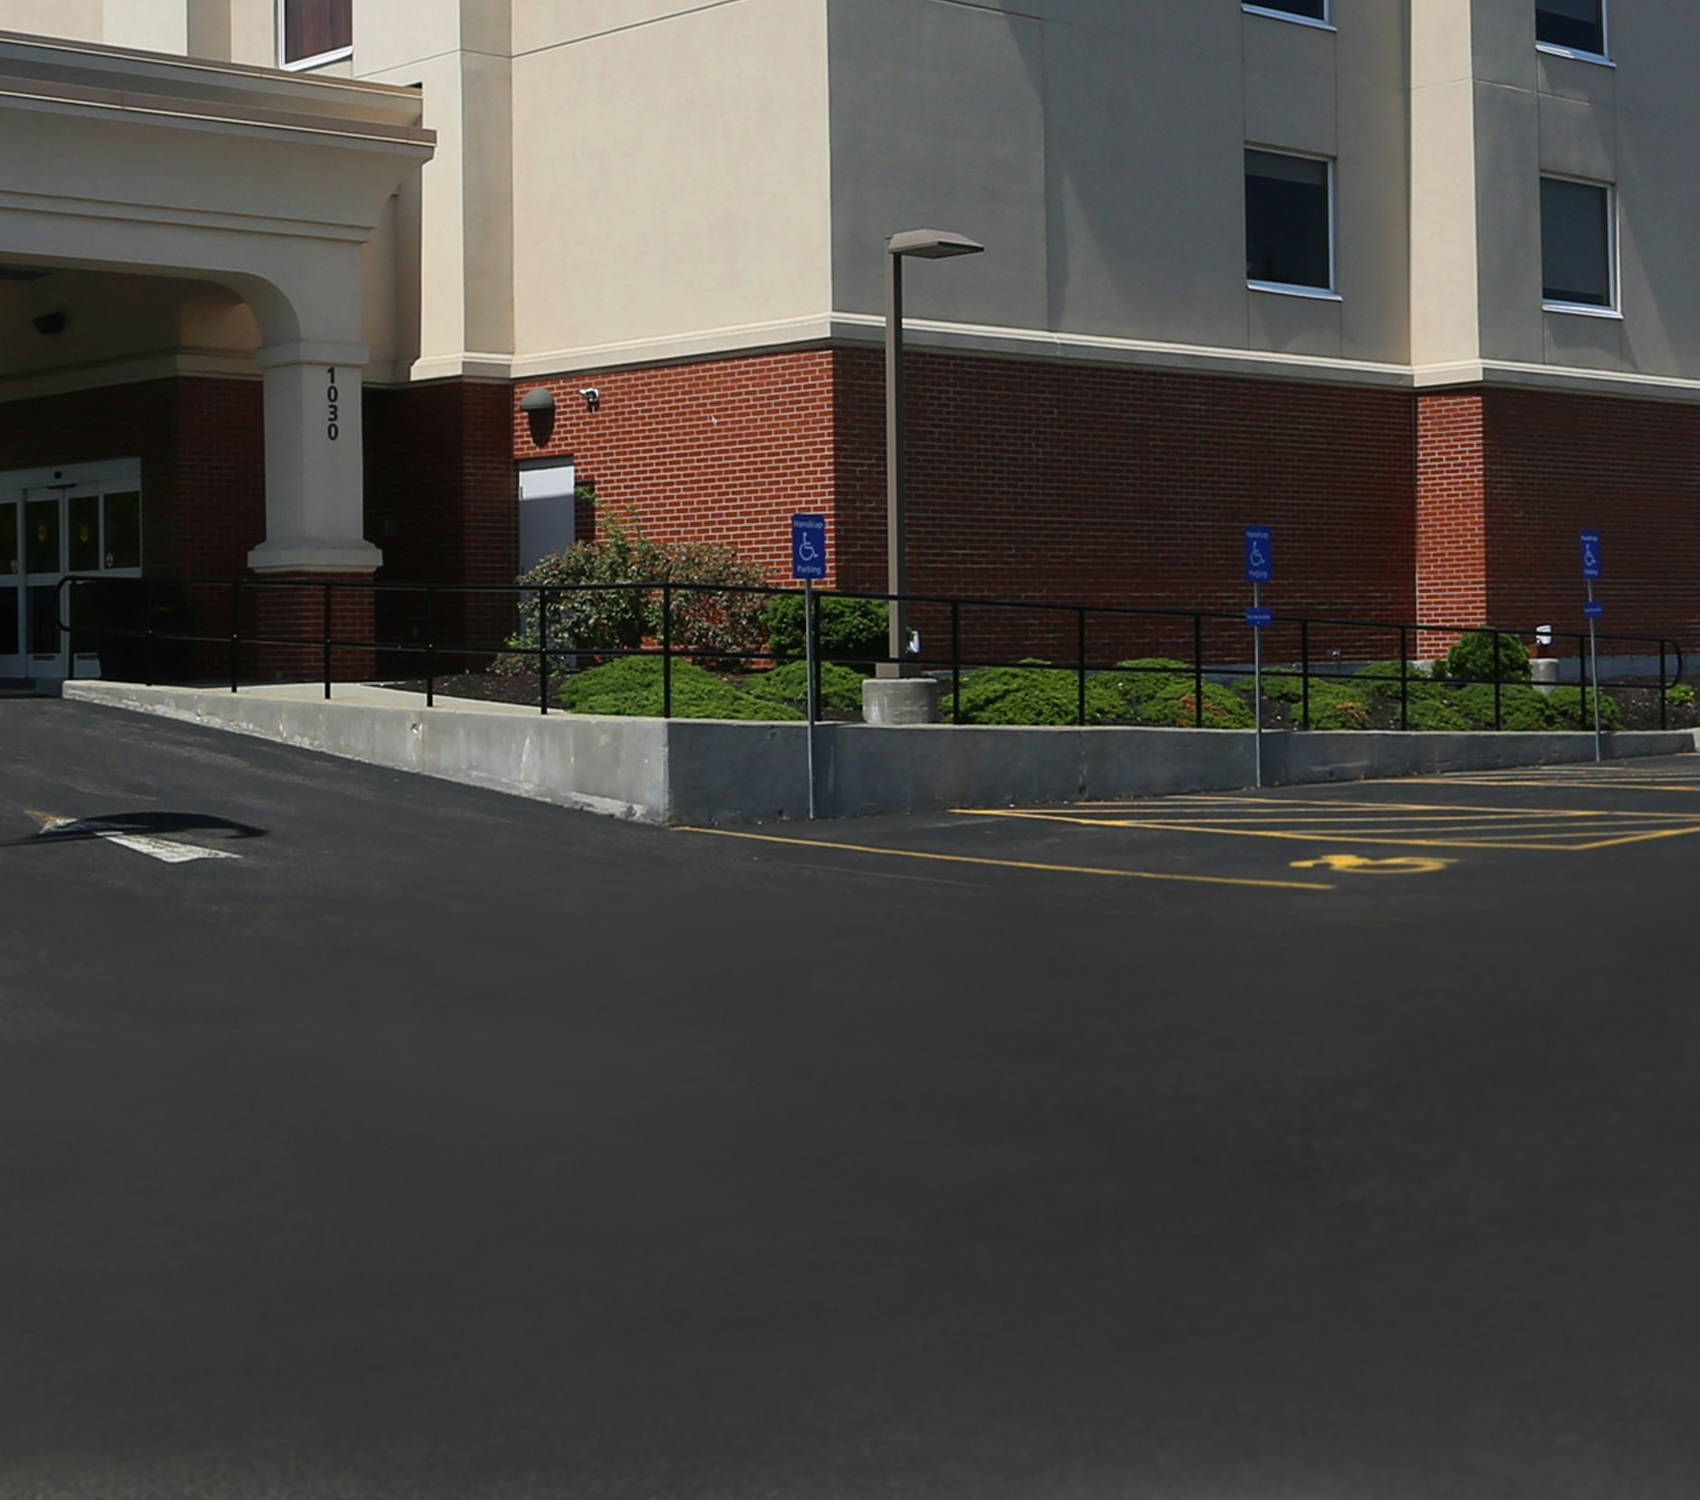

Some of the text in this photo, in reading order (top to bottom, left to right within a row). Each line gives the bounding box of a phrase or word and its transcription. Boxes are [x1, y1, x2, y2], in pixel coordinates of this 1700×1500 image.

[326, 366, 338, 441] 1030
[794, 520, 823, 529] Handicap
[797, 565, 821, 575] Parking
